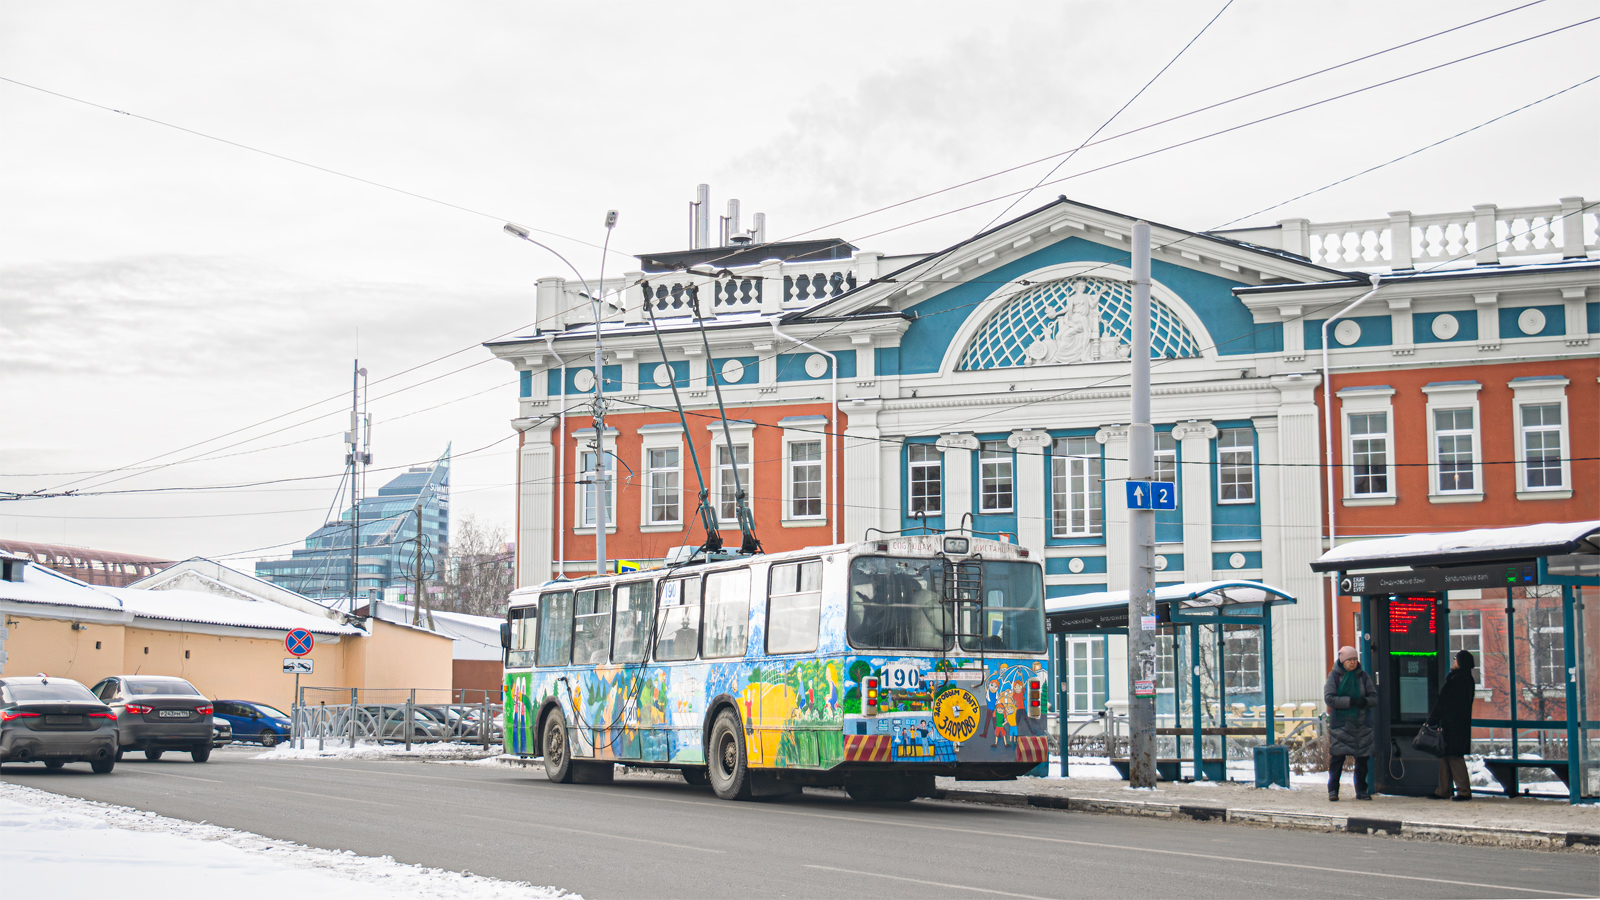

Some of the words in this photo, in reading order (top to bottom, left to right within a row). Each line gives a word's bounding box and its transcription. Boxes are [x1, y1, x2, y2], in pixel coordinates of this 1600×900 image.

[1159, 489, 1167, 503] 2
[665, 583, 677, 598] 190
[881, 668, 919, 687] 190
[934, 689, 960, 718] ЗДОРОВЫМ
[962, 691, 979, 714] БЫТЬ
[938, 716, 976, 739] ЗДОРОВО
